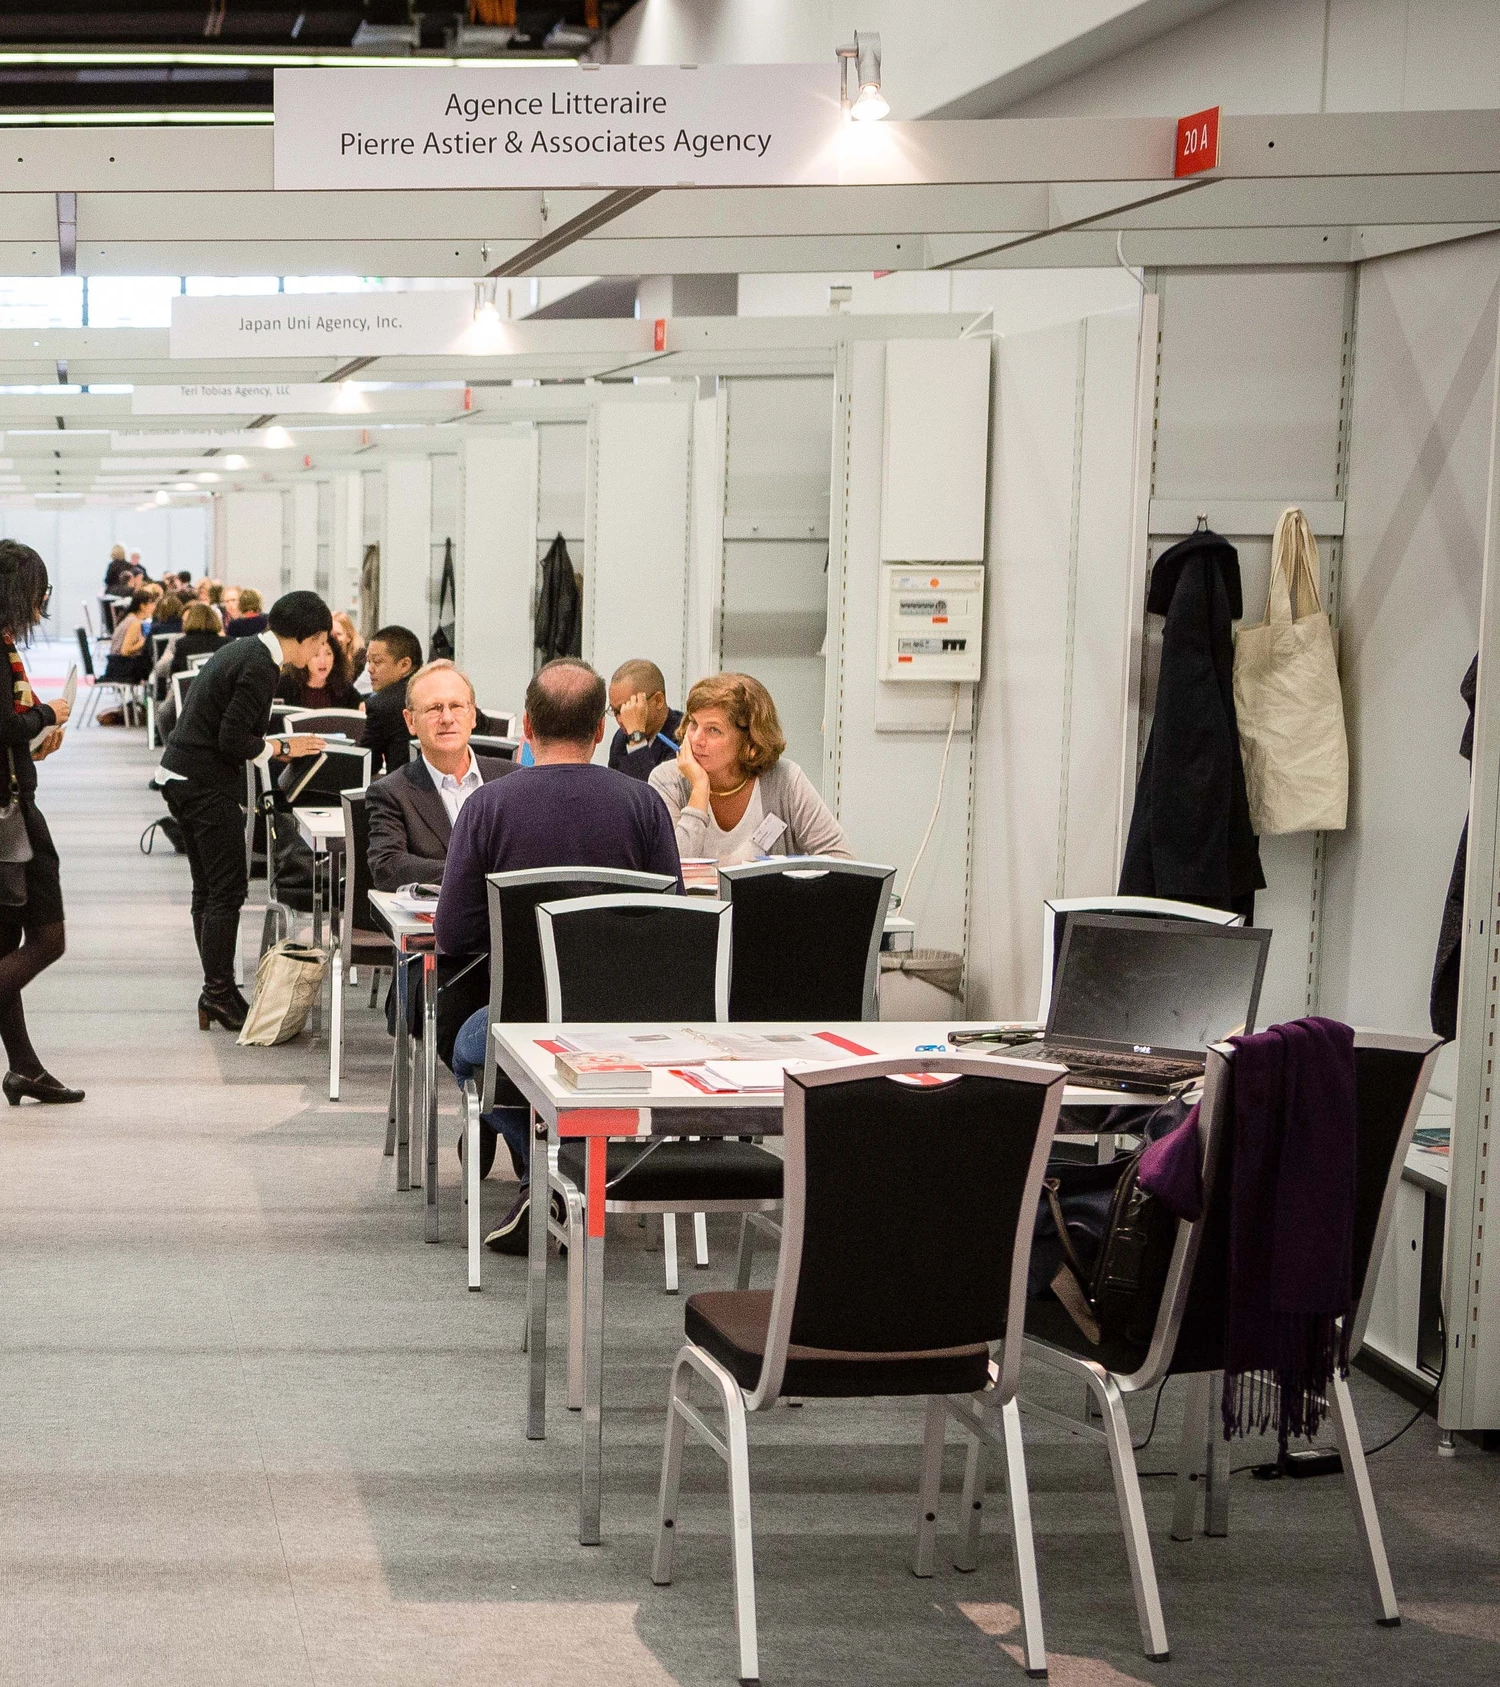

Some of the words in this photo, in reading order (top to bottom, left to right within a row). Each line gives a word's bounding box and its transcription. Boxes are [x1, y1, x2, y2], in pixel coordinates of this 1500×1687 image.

[444, 93, 543, 121] Agence
[552, 90, 668, 115] Litteraire
[341, 132, 415, 156] Pierre
[422, 131, 498, 155] Astier
[504, 131, 523, 154] &
[530, 129, 666, 153] Associates
[673, 130, 772, 158] Agency
[1183, 130, 1198, 156] 20
[1200, 123, 1208, 151] A
[239, 318, 281, 333] Japan
[287, 317, 310, 330] Uni
[316, 316, 371, 333] Agency,
[377, 316, 403, 329] Inc.
[201, 386, 232, 396] Tobias
